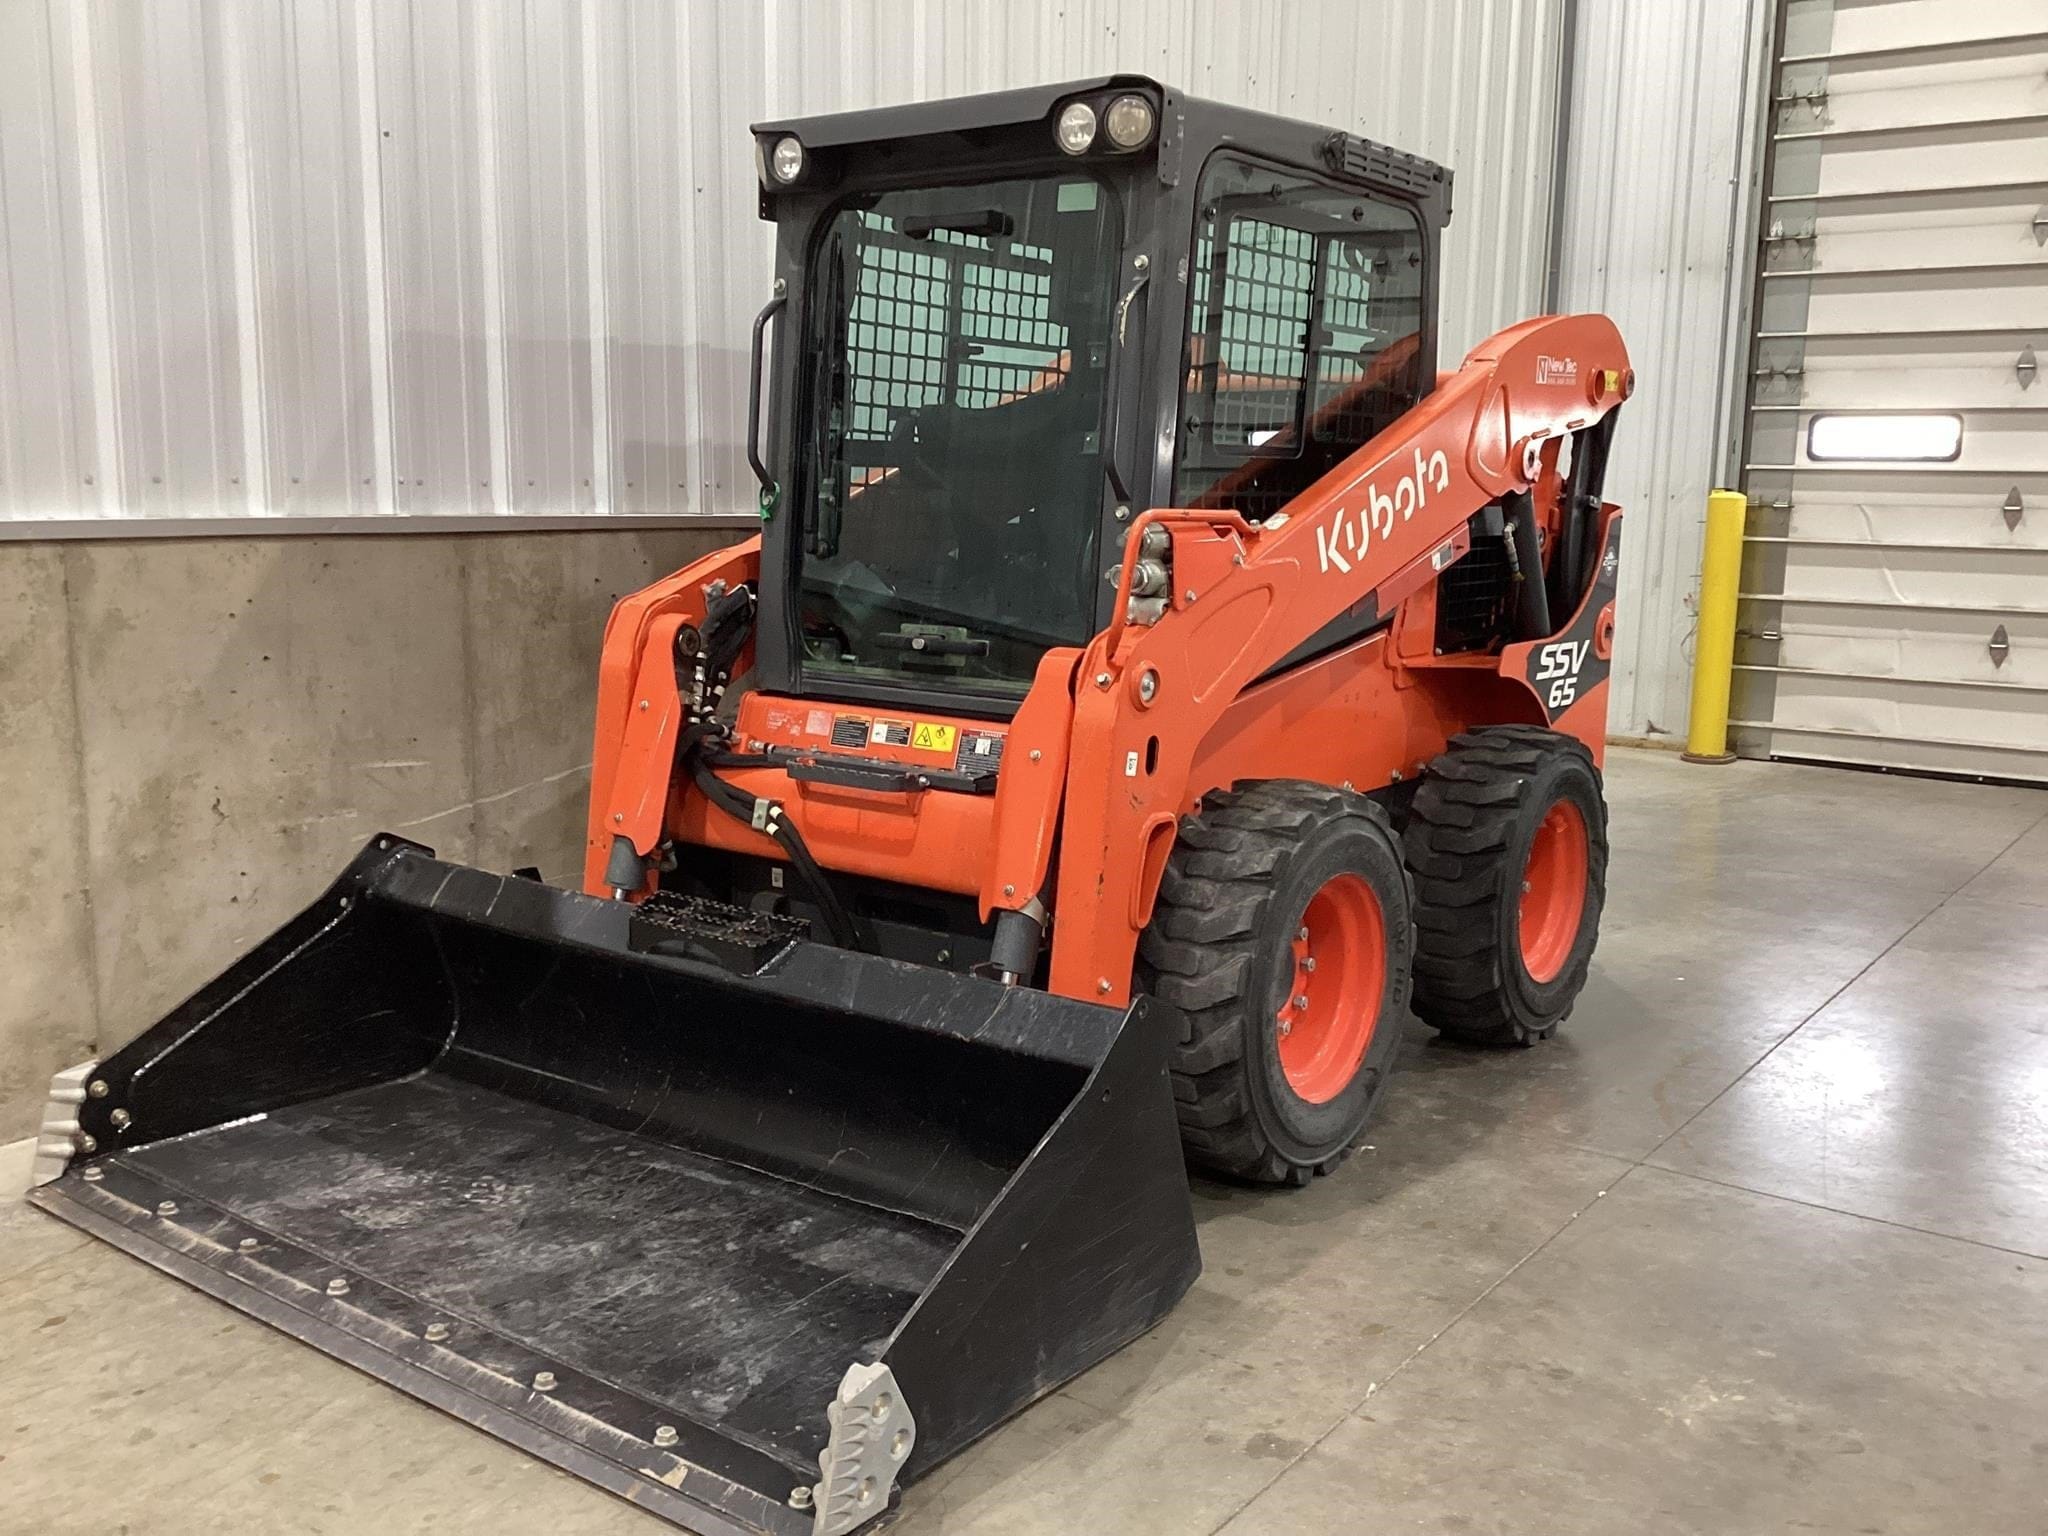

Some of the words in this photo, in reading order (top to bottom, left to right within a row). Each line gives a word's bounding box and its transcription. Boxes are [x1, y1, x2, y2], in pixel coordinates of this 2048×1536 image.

[1548, 356, 1564, 373] New
[1316, 447, 1449, 574] Kubota
[1536, 640, 1590, 680] SSV
[1548, 677, 1577, 708] 65
